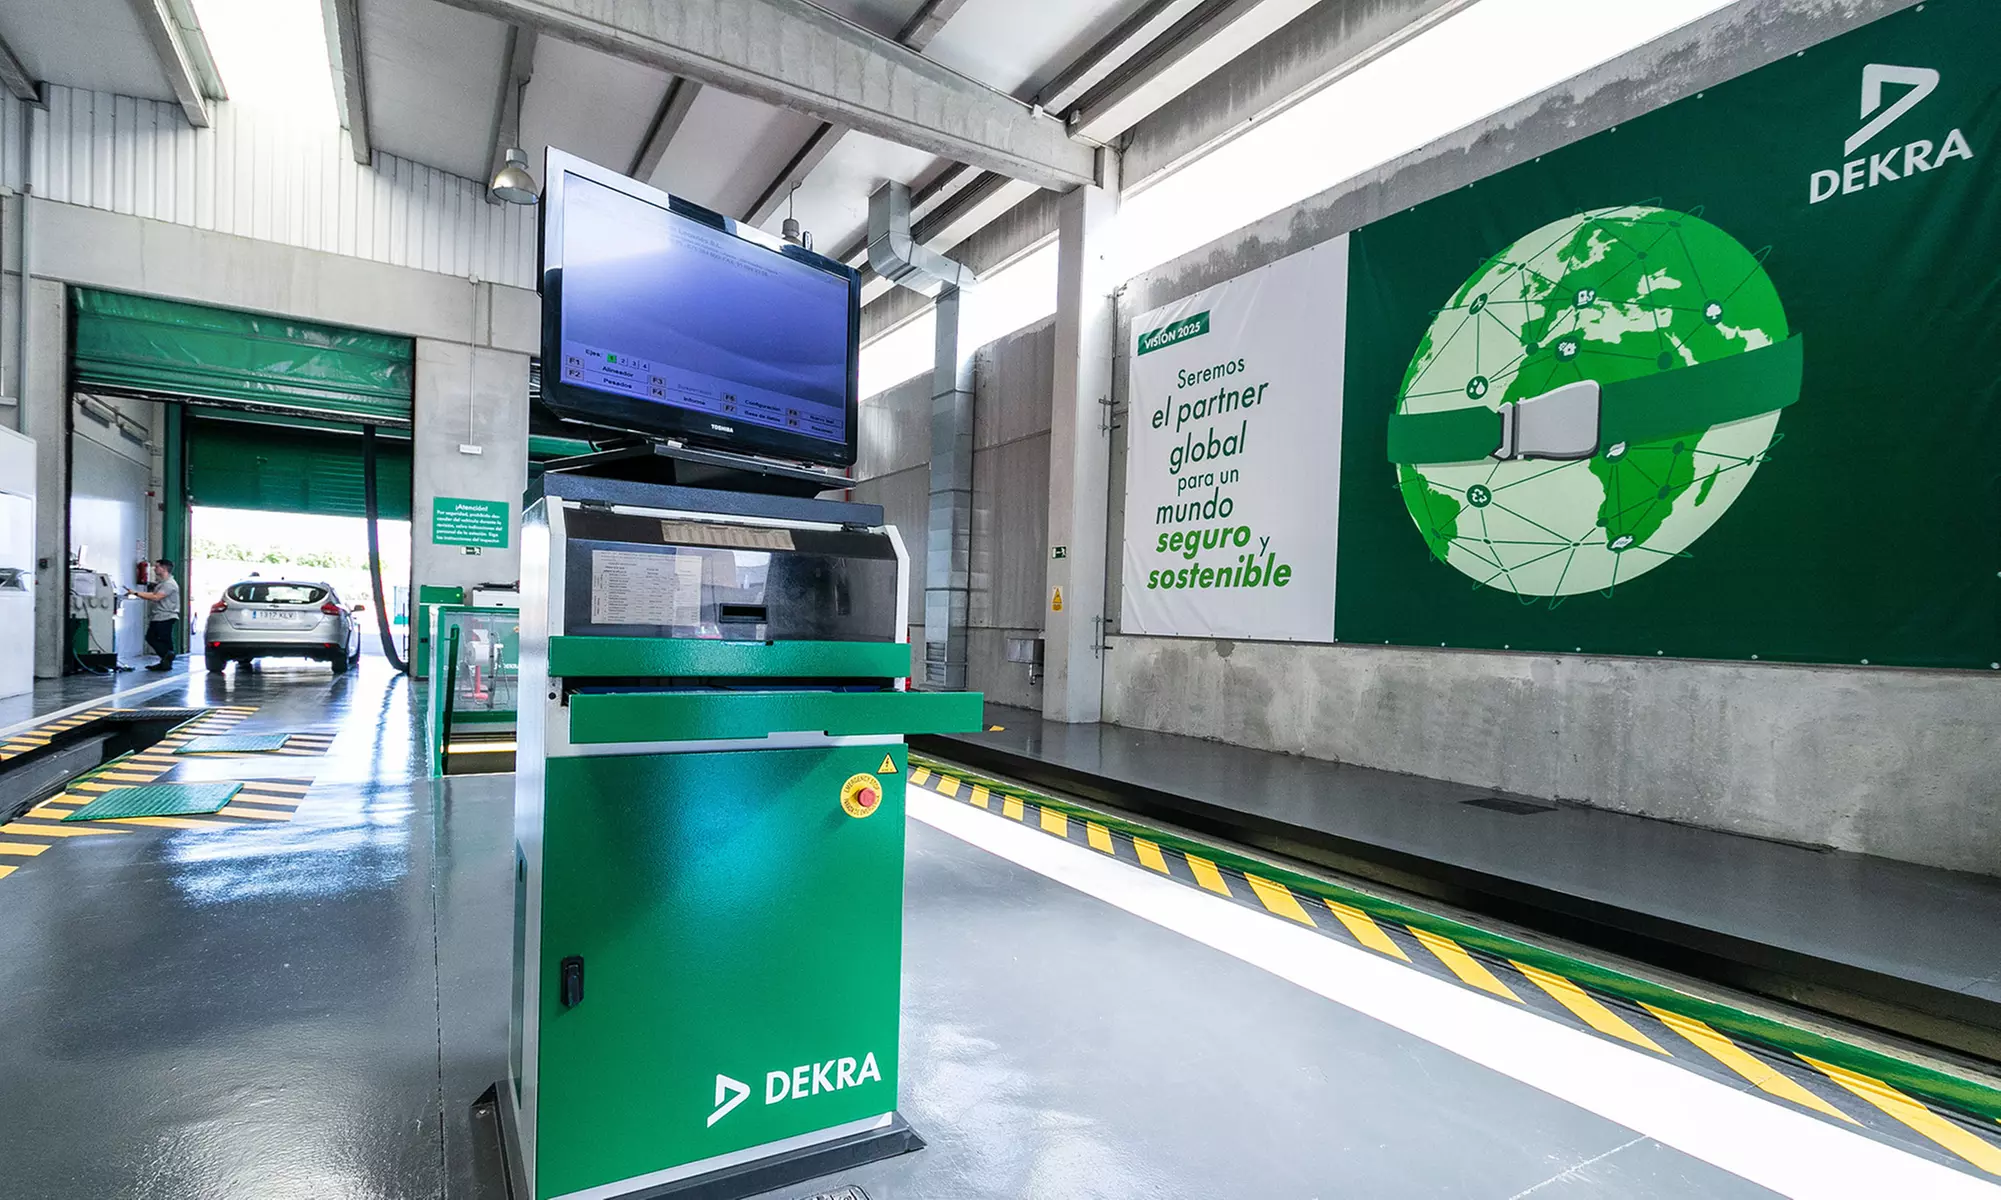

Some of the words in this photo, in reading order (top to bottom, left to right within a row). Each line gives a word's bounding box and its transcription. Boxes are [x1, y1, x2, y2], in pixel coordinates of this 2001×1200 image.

[1810, 129, 1974, 204] DEKRA
[1178, 321, 1201, 339] 2025
[569, 357, 581, 366] F1
[602, 366, 634, 378] Alineador
[569, 370, 581, 378] F2
[603, 378, 632, 389] Pesados
[652, 377, 663, 385] F3
[1177, 358, 1245, 389] Seremos
[652, 388, 663, 397] F4
[683, 396, 706, 406] Informe
[1151, 395, 1172, 429] el
[1175, 382, 1269, 433] partner
[711, 423, 734, 433] TOSHIBA
[1169, 419, 1247, 475] global
[1177, 473, 1214, 497] para
[1220, 469, 1239, 484] un
[1156, 486, 1234, 525] mundo
[1155, 525, 1251, 560] seguro
[1259, 536, 1270, 557] y
[1147, 552, 1292, 590] sostenible
[765, 1052, 882, 1105] DEKRA
